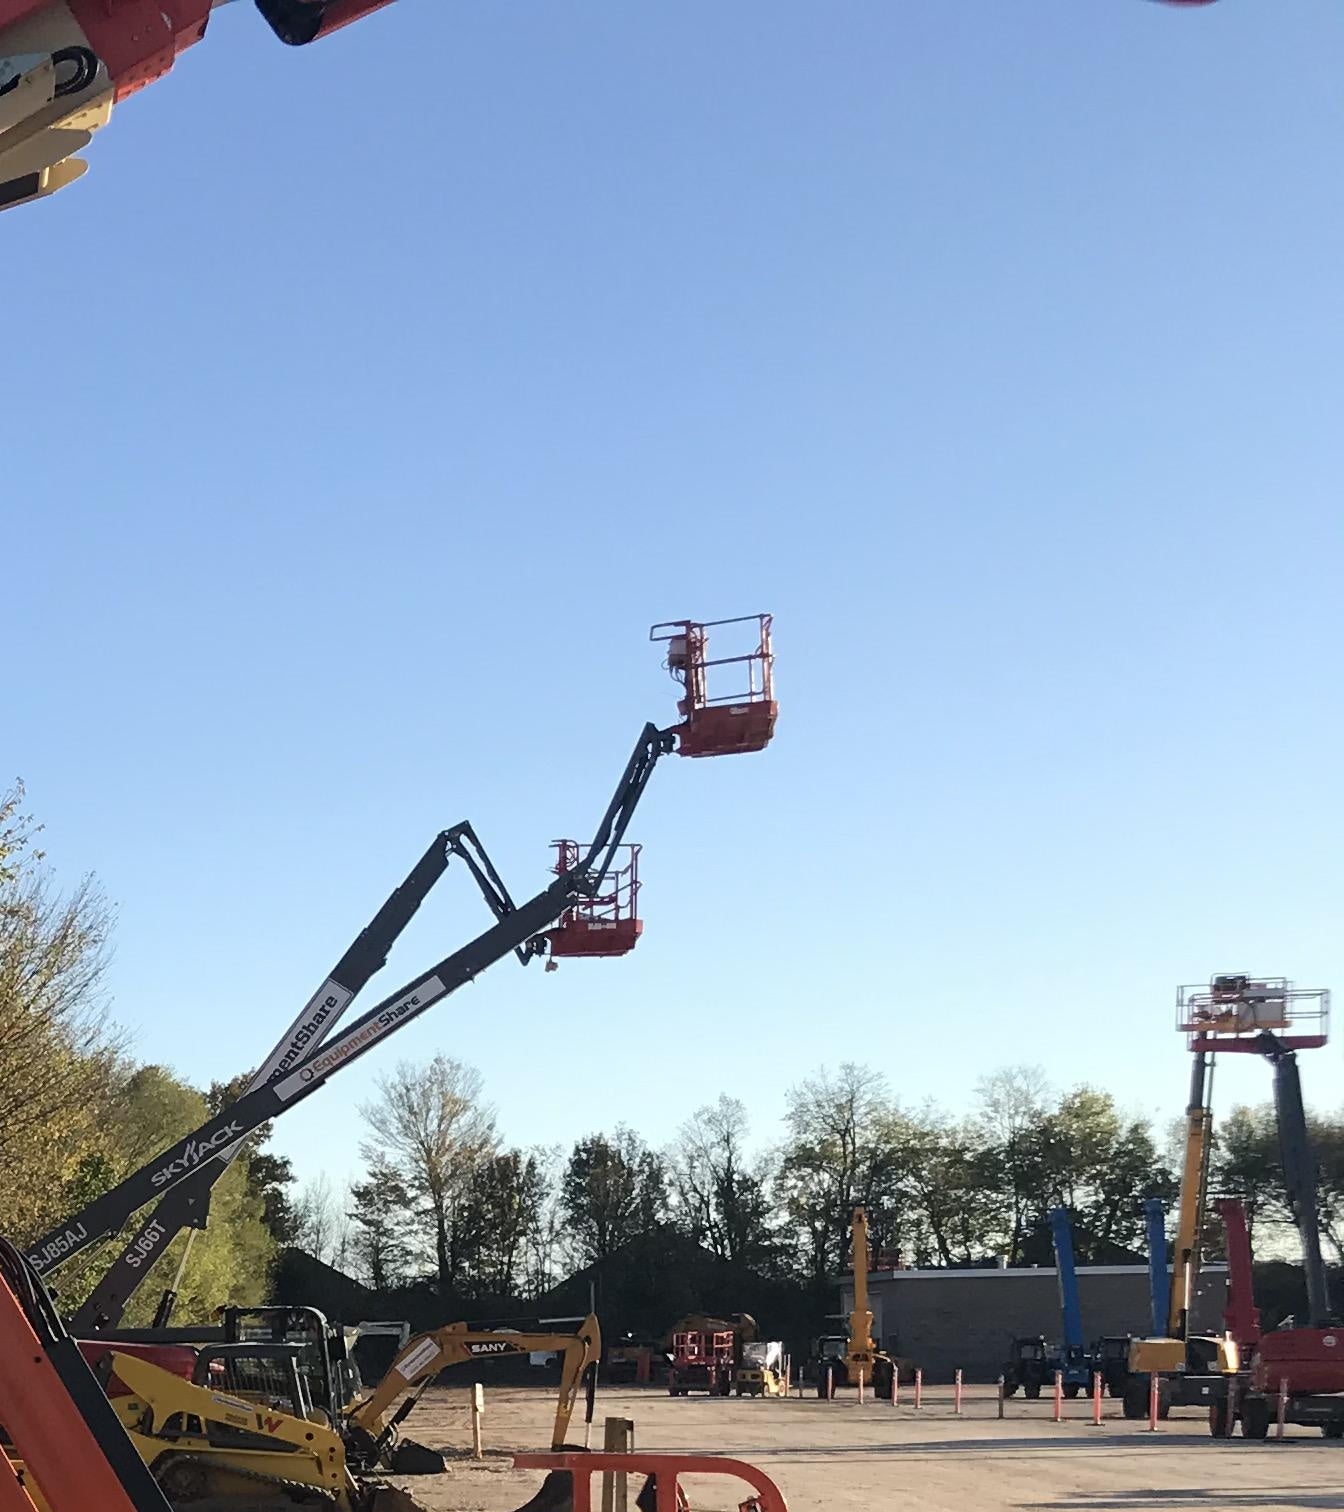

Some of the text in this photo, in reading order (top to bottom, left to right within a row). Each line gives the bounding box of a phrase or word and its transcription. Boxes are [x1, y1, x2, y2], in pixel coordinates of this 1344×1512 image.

[313, 995, 420, 1072] EquipmentShare
[151, 1120, 244, 1187] SKYJACK
[29, 1222, 88, 1271] SJ85AJ
[125, 1219, 167, 1268] SJ66T
[471, 1342, 507, 1354] SANY
